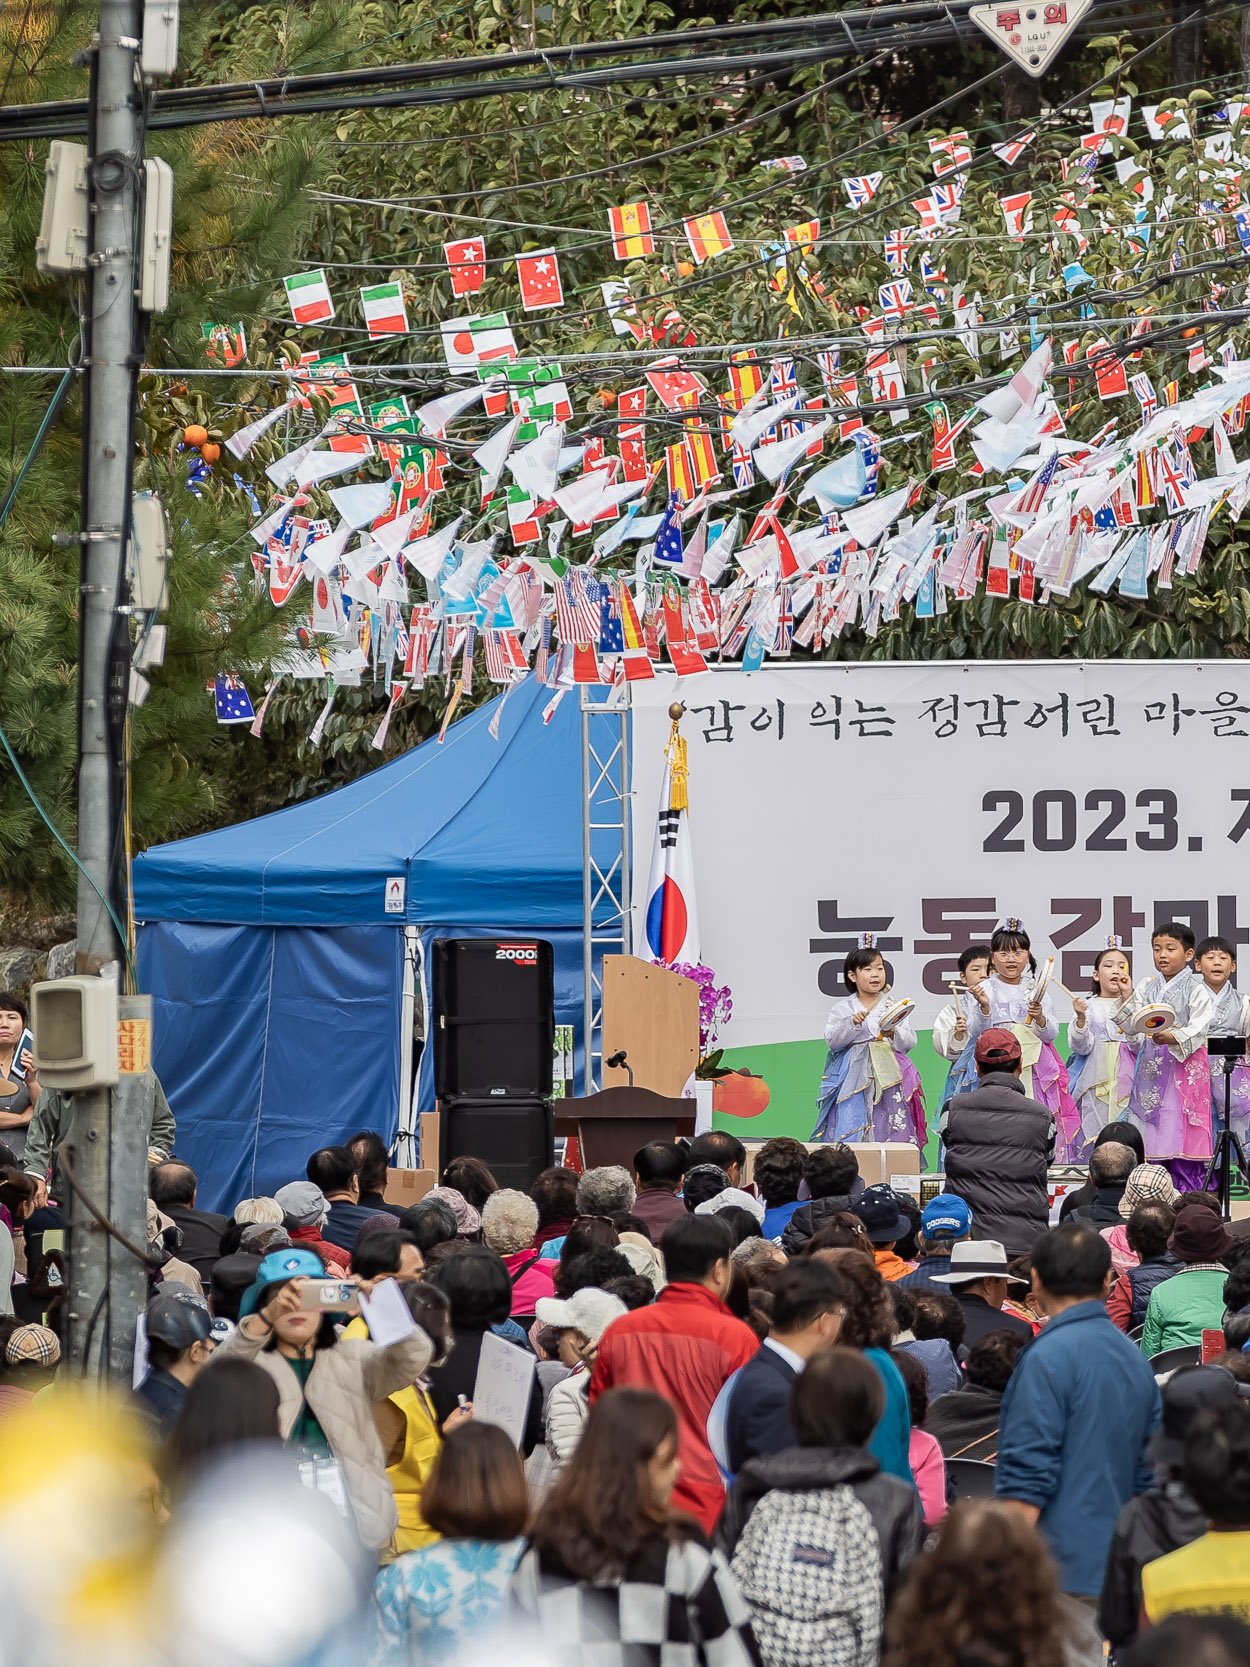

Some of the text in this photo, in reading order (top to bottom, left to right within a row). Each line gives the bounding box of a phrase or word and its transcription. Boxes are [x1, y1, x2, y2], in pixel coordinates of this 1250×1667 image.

[808, 694, 896, 741] 익는
[982, 789, 1202, 852] 2023.
[926, 1217, 961, 1230] DODGERS
